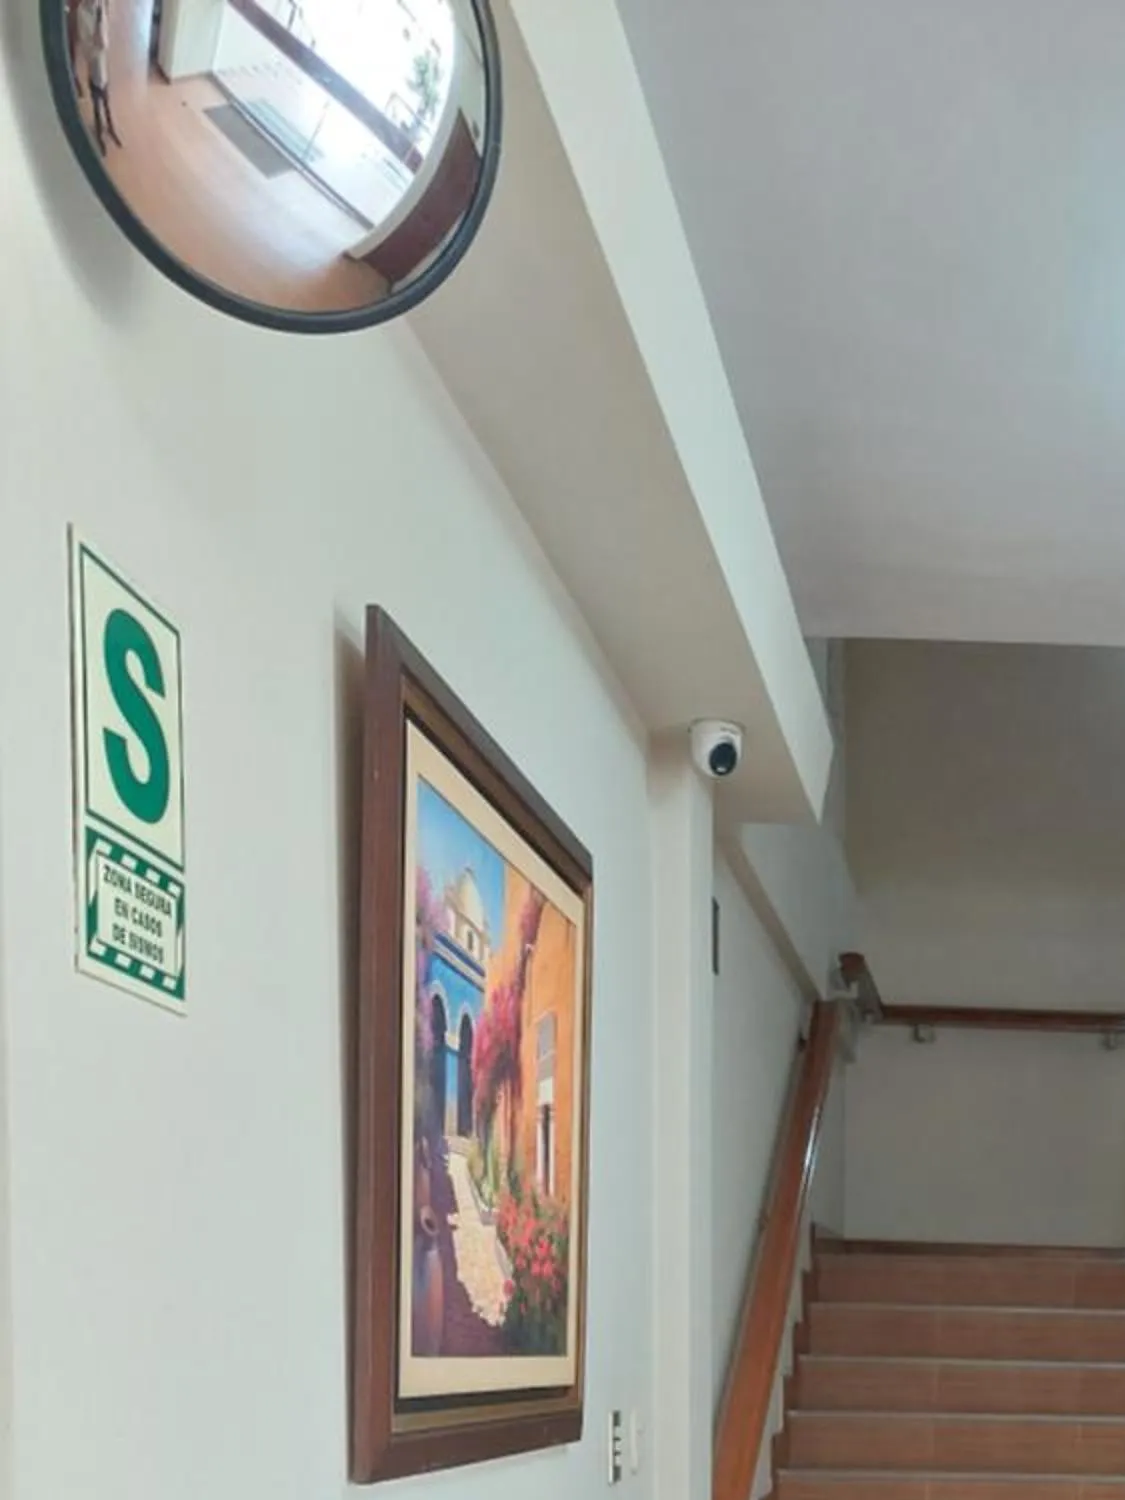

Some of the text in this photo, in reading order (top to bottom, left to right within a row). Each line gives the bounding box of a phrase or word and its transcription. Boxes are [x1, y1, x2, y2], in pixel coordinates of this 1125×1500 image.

[102, 608, 170, 824] S
[103, 864, 171, 916] ZONA SEGURA
[114, 897, 129, 918] EN
[112, 923, 126, 945] DE
